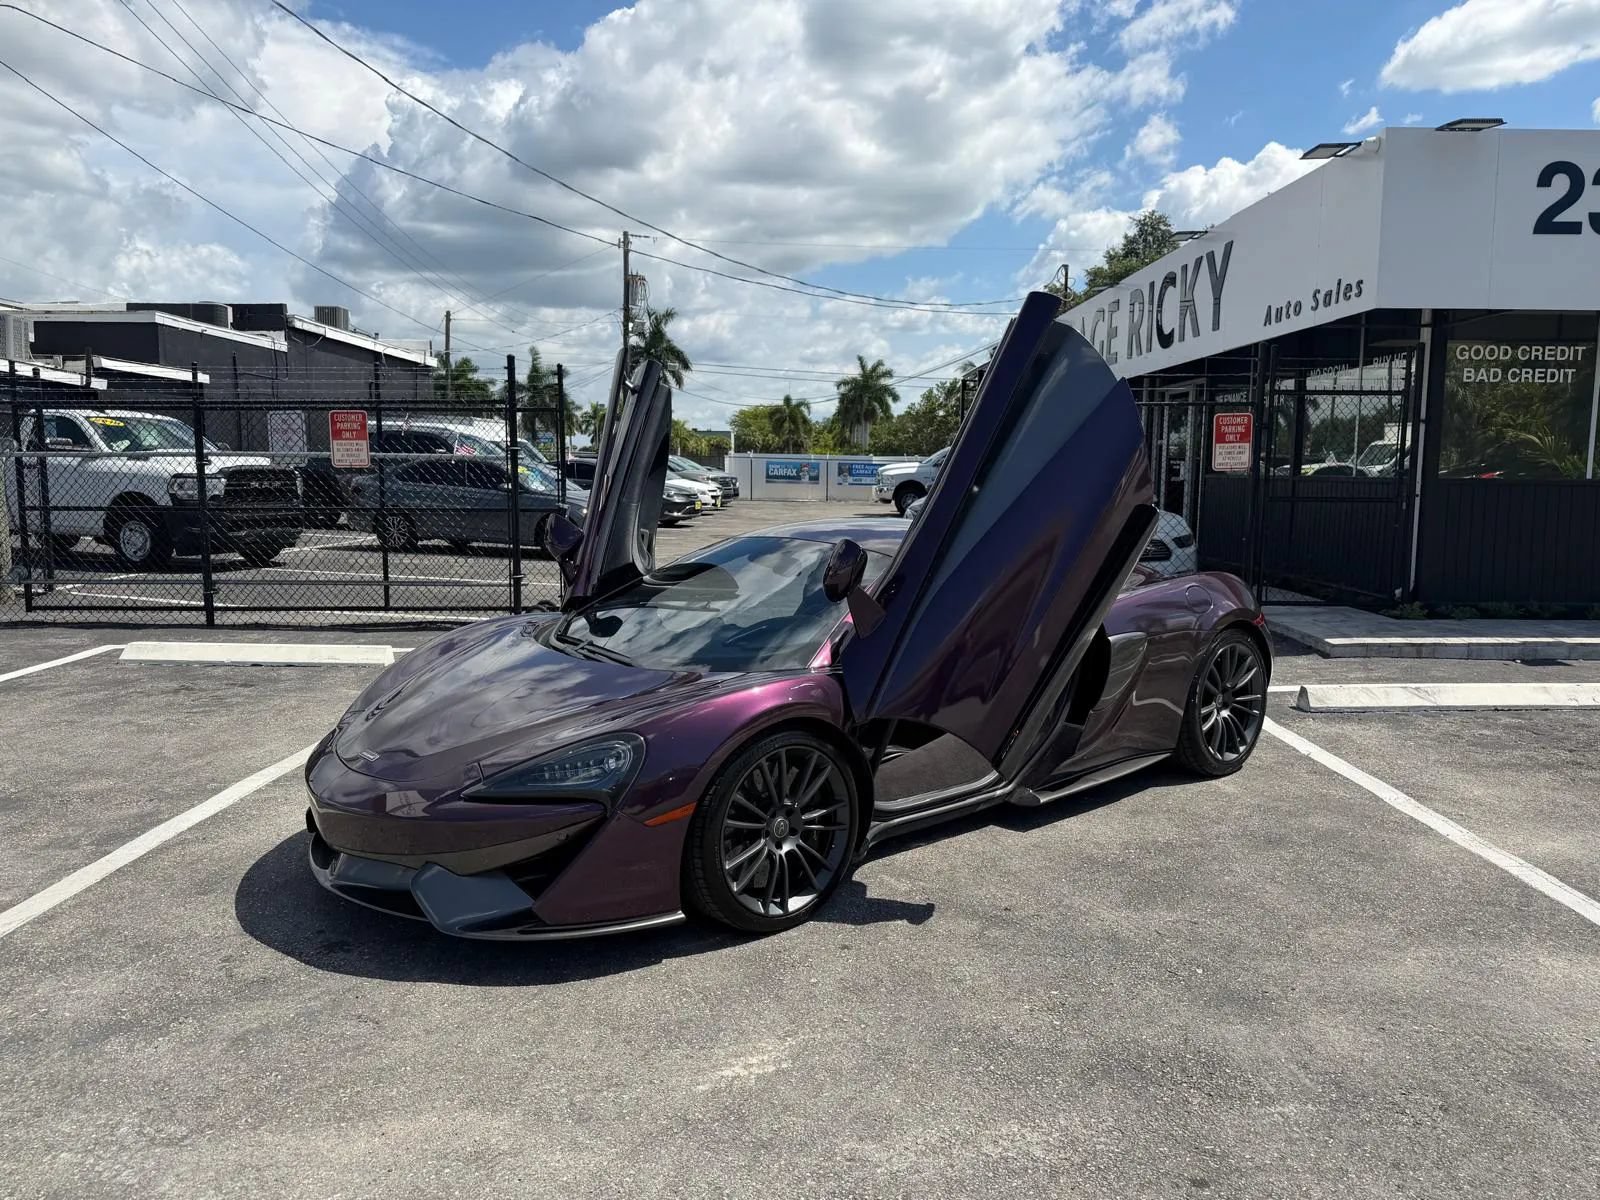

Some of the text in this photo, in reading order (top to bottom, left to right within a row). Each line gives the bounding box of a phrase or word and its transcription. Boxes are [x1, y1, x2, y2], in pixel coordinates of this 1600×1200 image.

[1532, 160, 1600, 235] 2
[1127, 240, 1234, 360] RICKY
[1263, 278, 1364, 327] Auto Sales
[1456, 345, 1586, 360] GOOD CREDIT
[1463, 368, 1576, 383] BAD CREDIT
[336, 422, 361, 430] PARKING
[1221, 425, 1245, 433] PARKING
[341, 431, 356, 439] ONLY
[1225, 434, 1240, 442] ONLY
[768, 468, 797, 476] CARFAX
